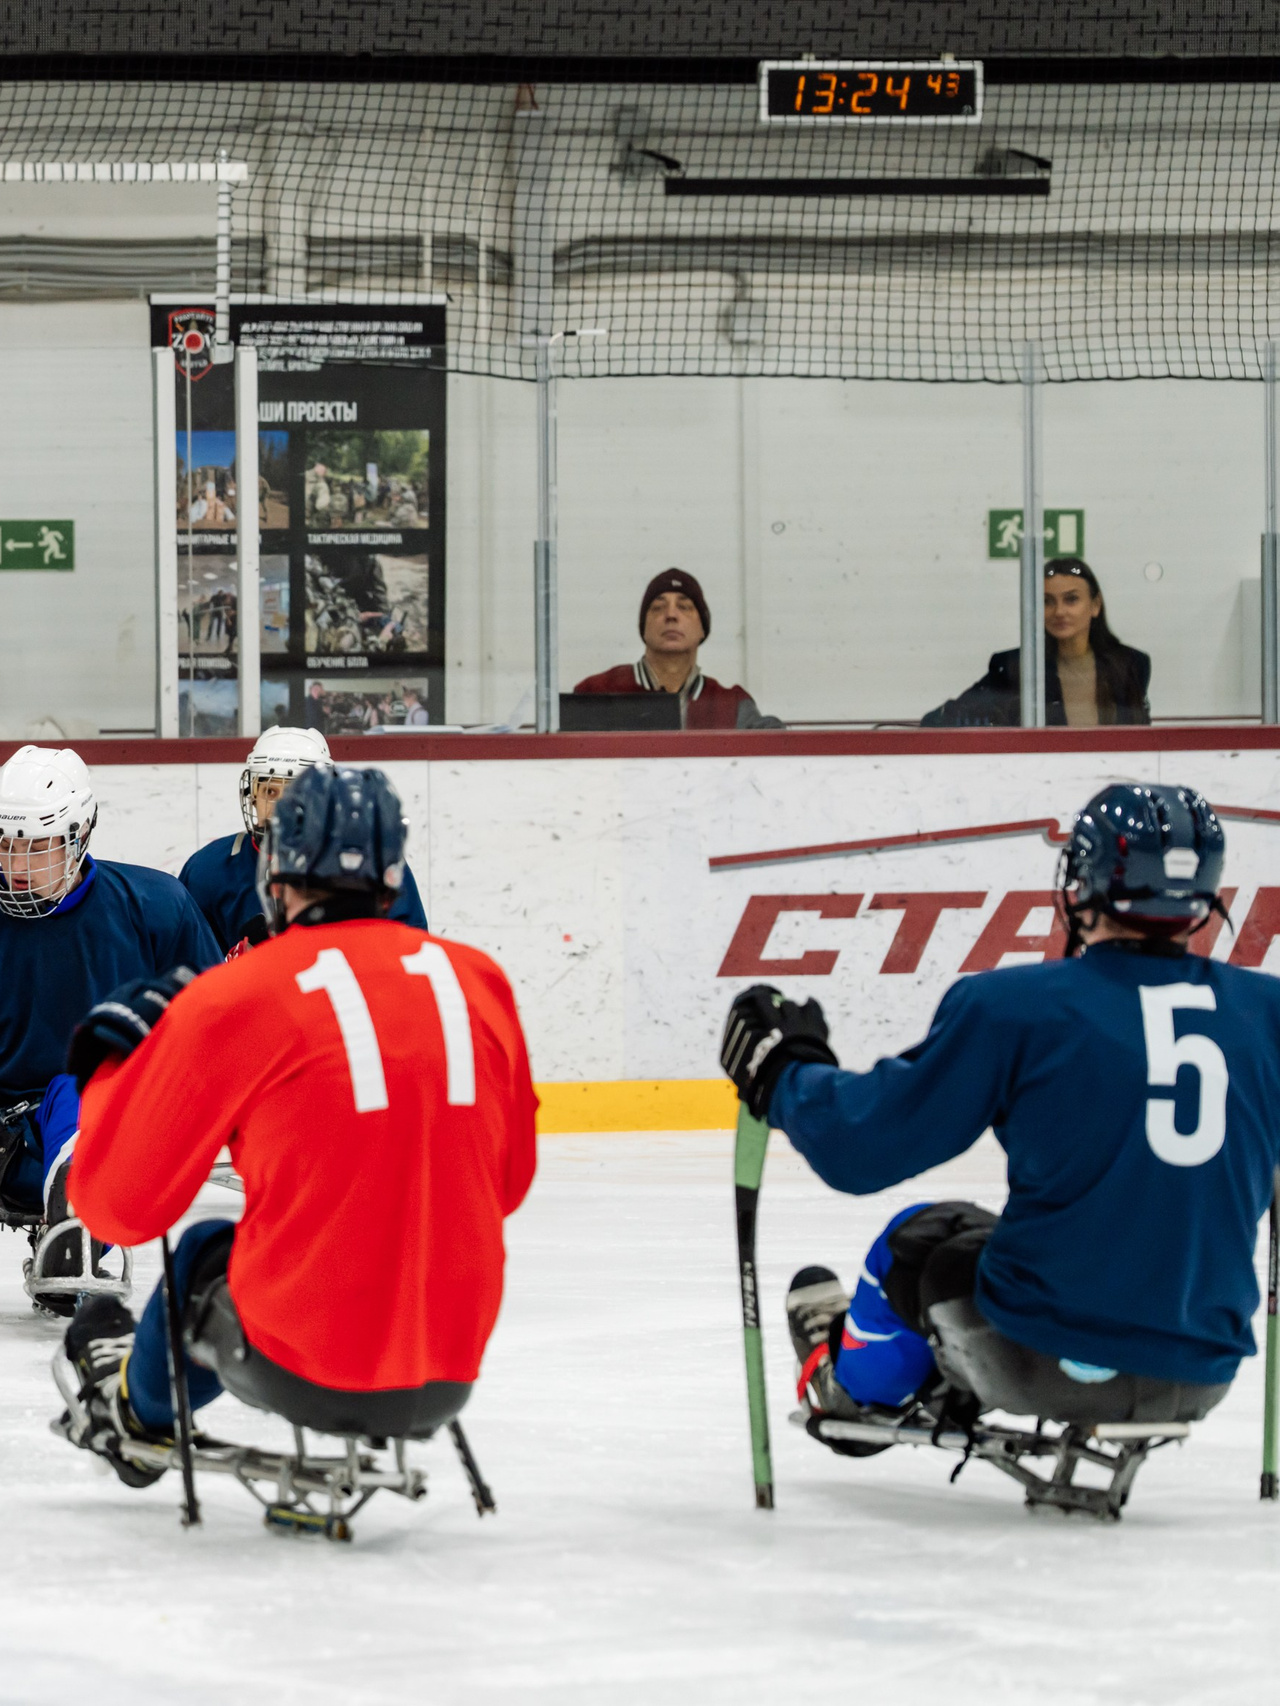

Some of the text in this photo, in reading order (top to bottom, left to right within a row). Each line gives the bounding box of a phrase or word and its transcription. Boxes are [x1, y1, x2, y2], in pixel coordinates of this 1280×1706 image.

[794, 72, 960, 113] 13:24 43
[258, 402, 357, 422] ШИ ПРОЕКТЫ
[295, 941, 476, 1113] 11
[1139, 982, 1229, 1168] 5
